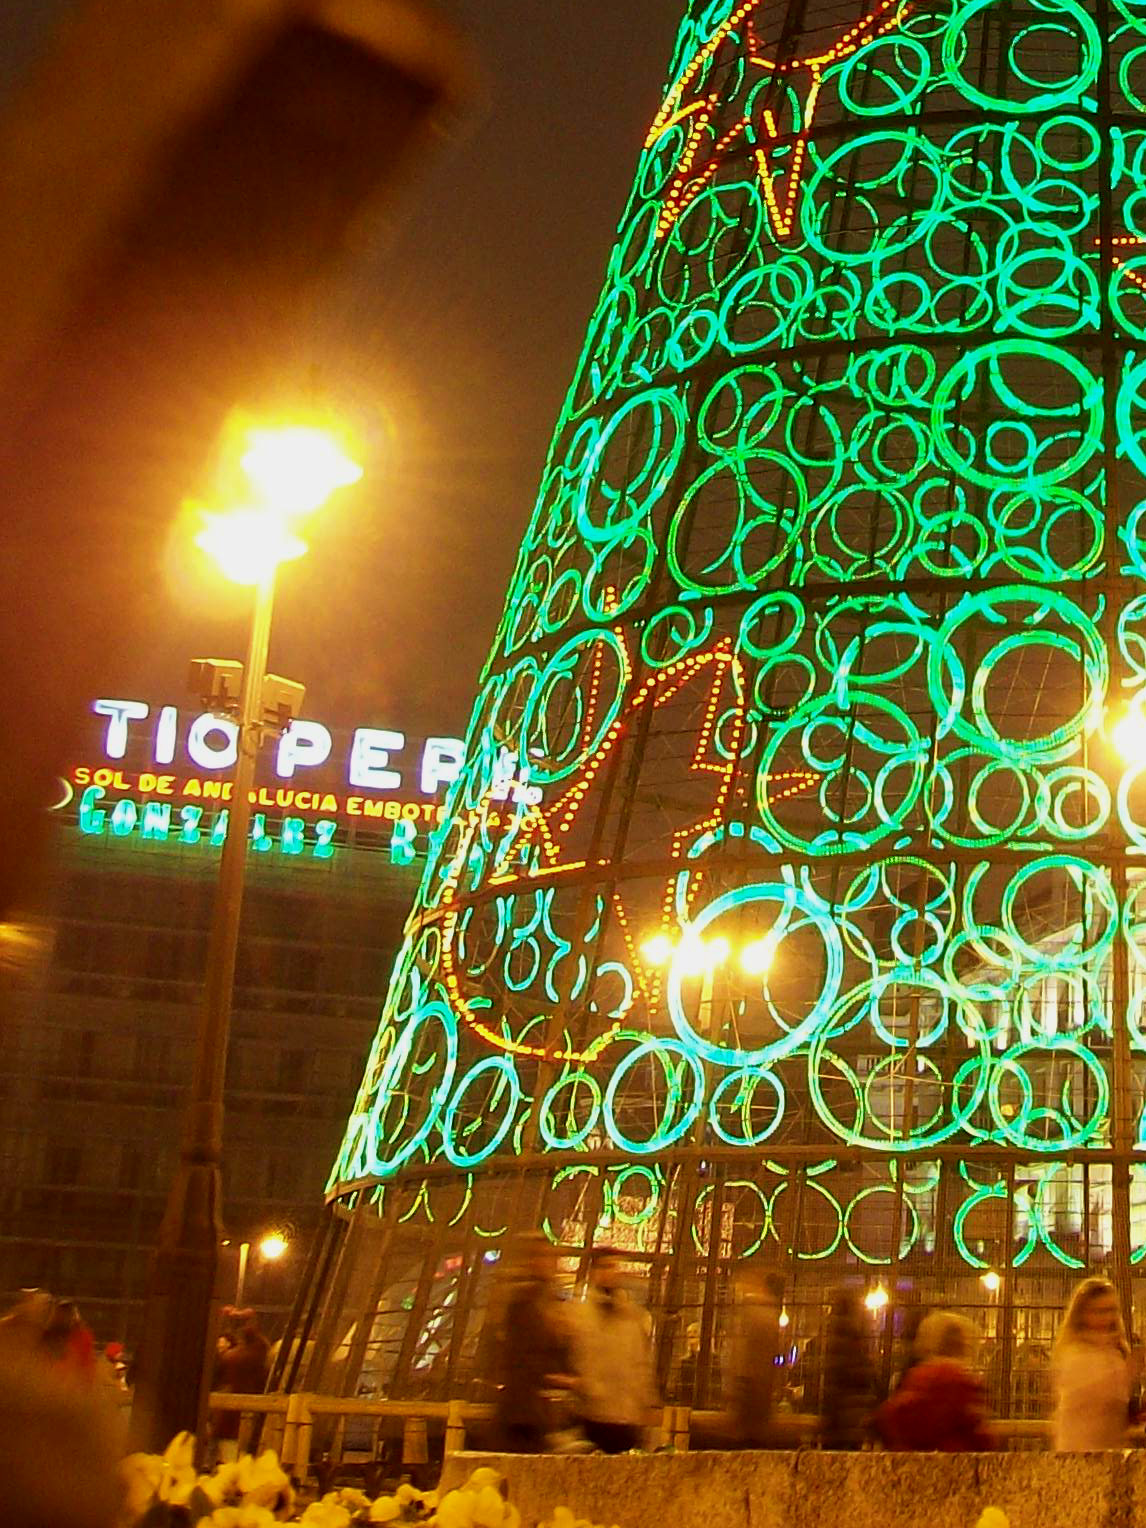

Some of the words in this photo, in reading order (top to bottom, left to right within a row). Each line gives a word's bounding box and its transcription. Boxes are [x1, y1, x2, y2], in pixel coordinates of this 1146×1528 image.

[94, 699, 240, 769] TIO
[75, 768, 131, 790] SOL
[138, 773, 176, 795] DE
[183, 779, 338, 813] ANDLUCIA
